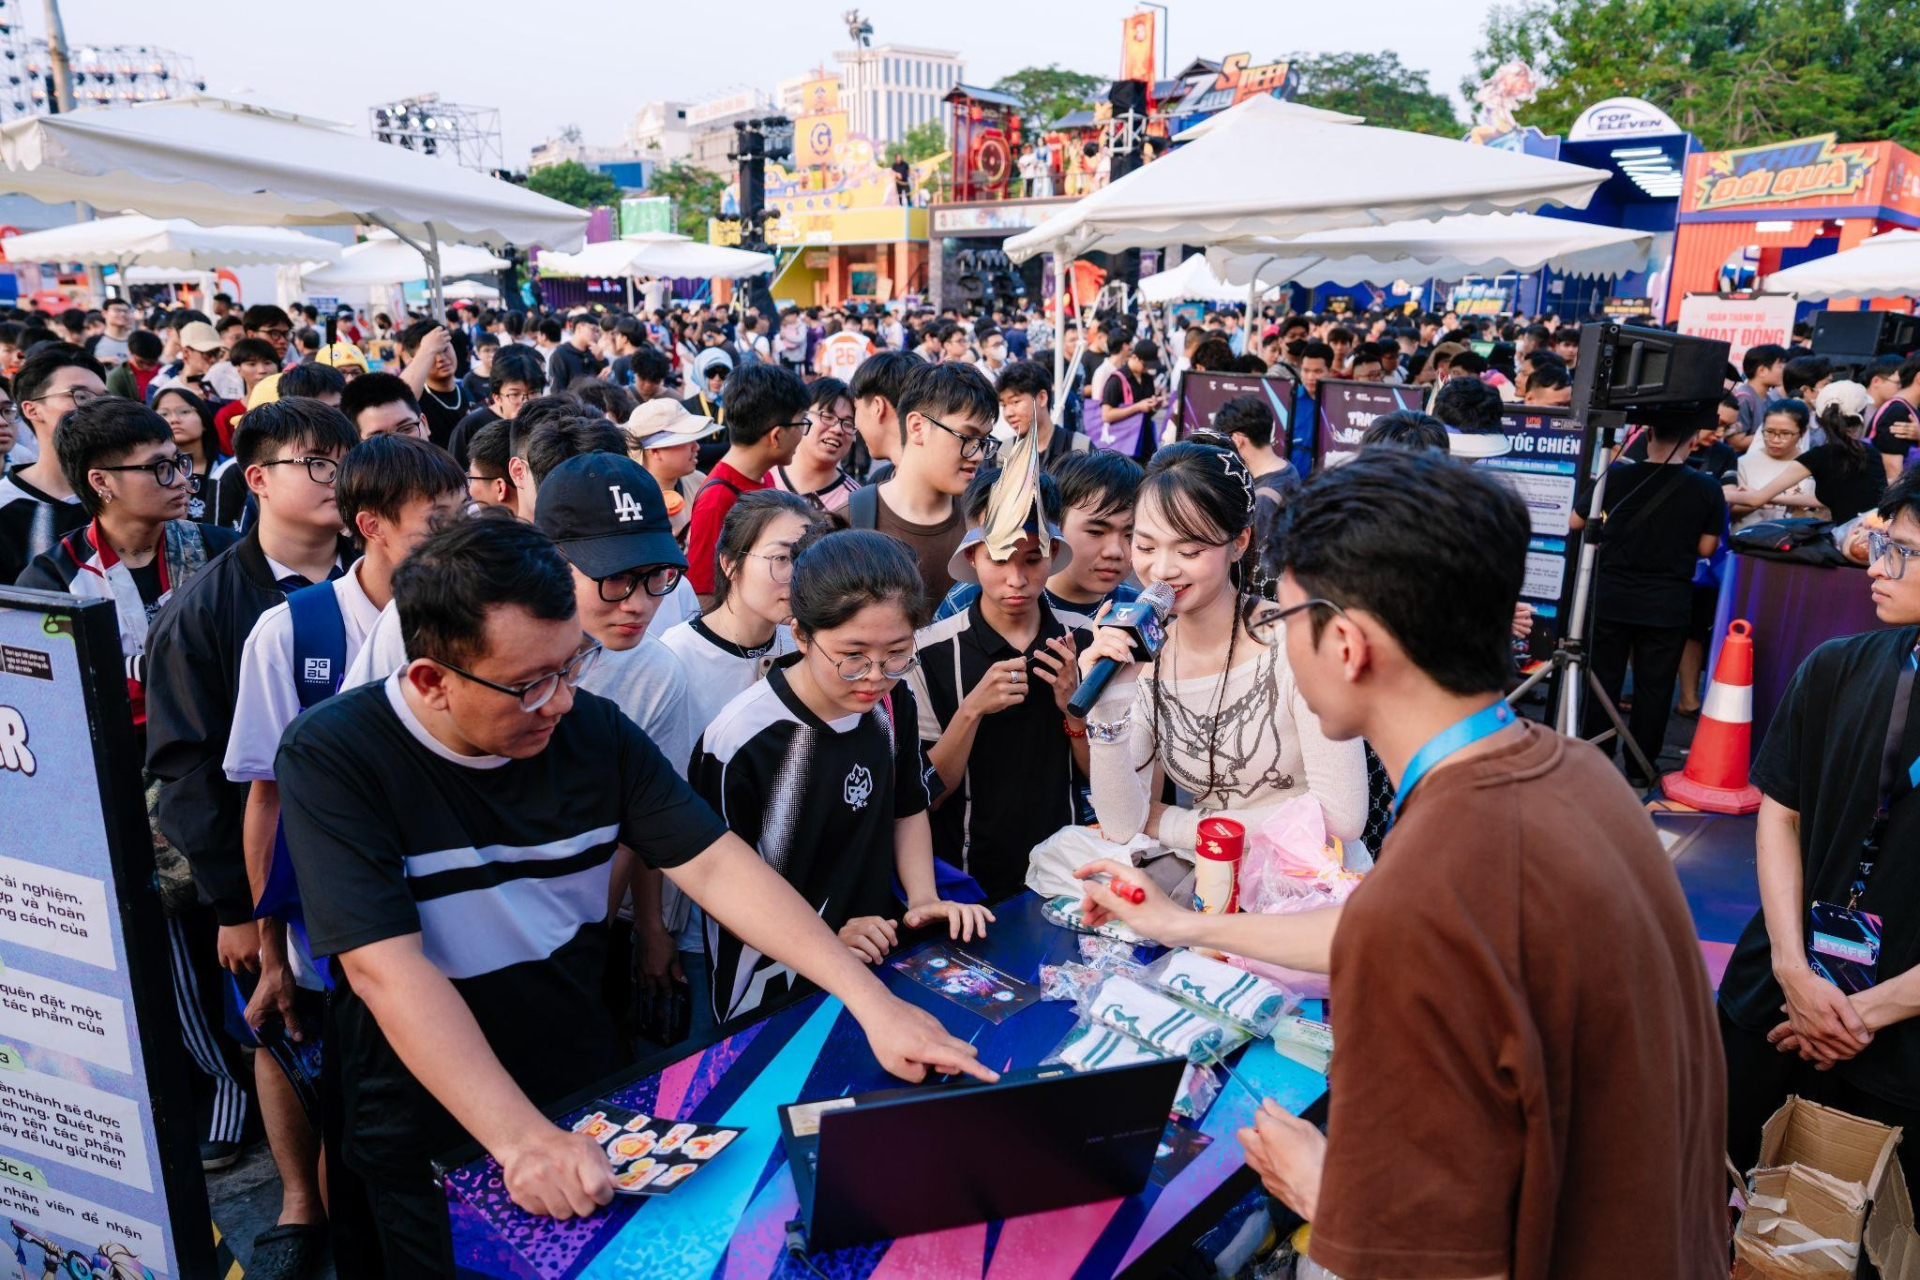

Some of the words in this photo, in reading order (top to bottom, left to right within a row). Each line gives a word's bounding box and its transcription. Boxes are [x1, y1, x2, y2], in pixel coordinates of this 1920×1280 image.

[1597, 113, 1632, 122] TOP
[1597, 119, 1662, 131] ELEVEN
[1736, 143, 1823, 177] KHU
[1771, 158, 1847, 195] QUÀ
[835, 347, 856, 366] 26
[1507, 432, 1534, 452] TỐC
[1536, 434, 1581, 455] CHIẾN
[609, 485, 643, 522] LA
[307, 669, 327, 678] BL
[308, 660, 328, 669] JG
[22, 882, 83, 905] nghiệm.
[21, 897, 39, 909] và
[47, 901, 85, 921] hoàn
[20, 912, 57, 929] cách
[60, 922, 88, 938] của
[1819, 938, 1867, 958] STAFF
[0, 983, 35, 1001] quên
[71, 1004, 102, 1021] một
[2, 998, 28, 1013] tác
[32, 1007, 74, 1027] phẩm
[77, 1019, 105, 1036] của
[18, 1088, 62, 1110] thành
[63, 1104, 81, 1116] sẽ
[83, 1109, 121, 1128] được
[2, 1098, 51, 1121] chung.
[55, 1113, 94, 1134] Quét
[99, 1129, 123, 1144] mã
[0, 1123, 18, 1137] áy
[21, 1129, 39, 1143] để
[41, 1135, 64, 1151] lưu
[66, 1144, 88, 1159] giữ
[91, 1153, 122, 1170] nhé!
[22, 1116, 48, 1132] tên
[53, 1127, 79, 1142] tác
[84, 1138, 126, 1158] phẩm
[23, 1171, 33, 1181] 4
[4, 1186, 39, 1203] nhân
[45, 1200, 75, 1216] viên
[82, 1211, 100, 1225] để
[106, 1221, 143, 1240] nhận
[14, 1202, 40, 1217] nhé
